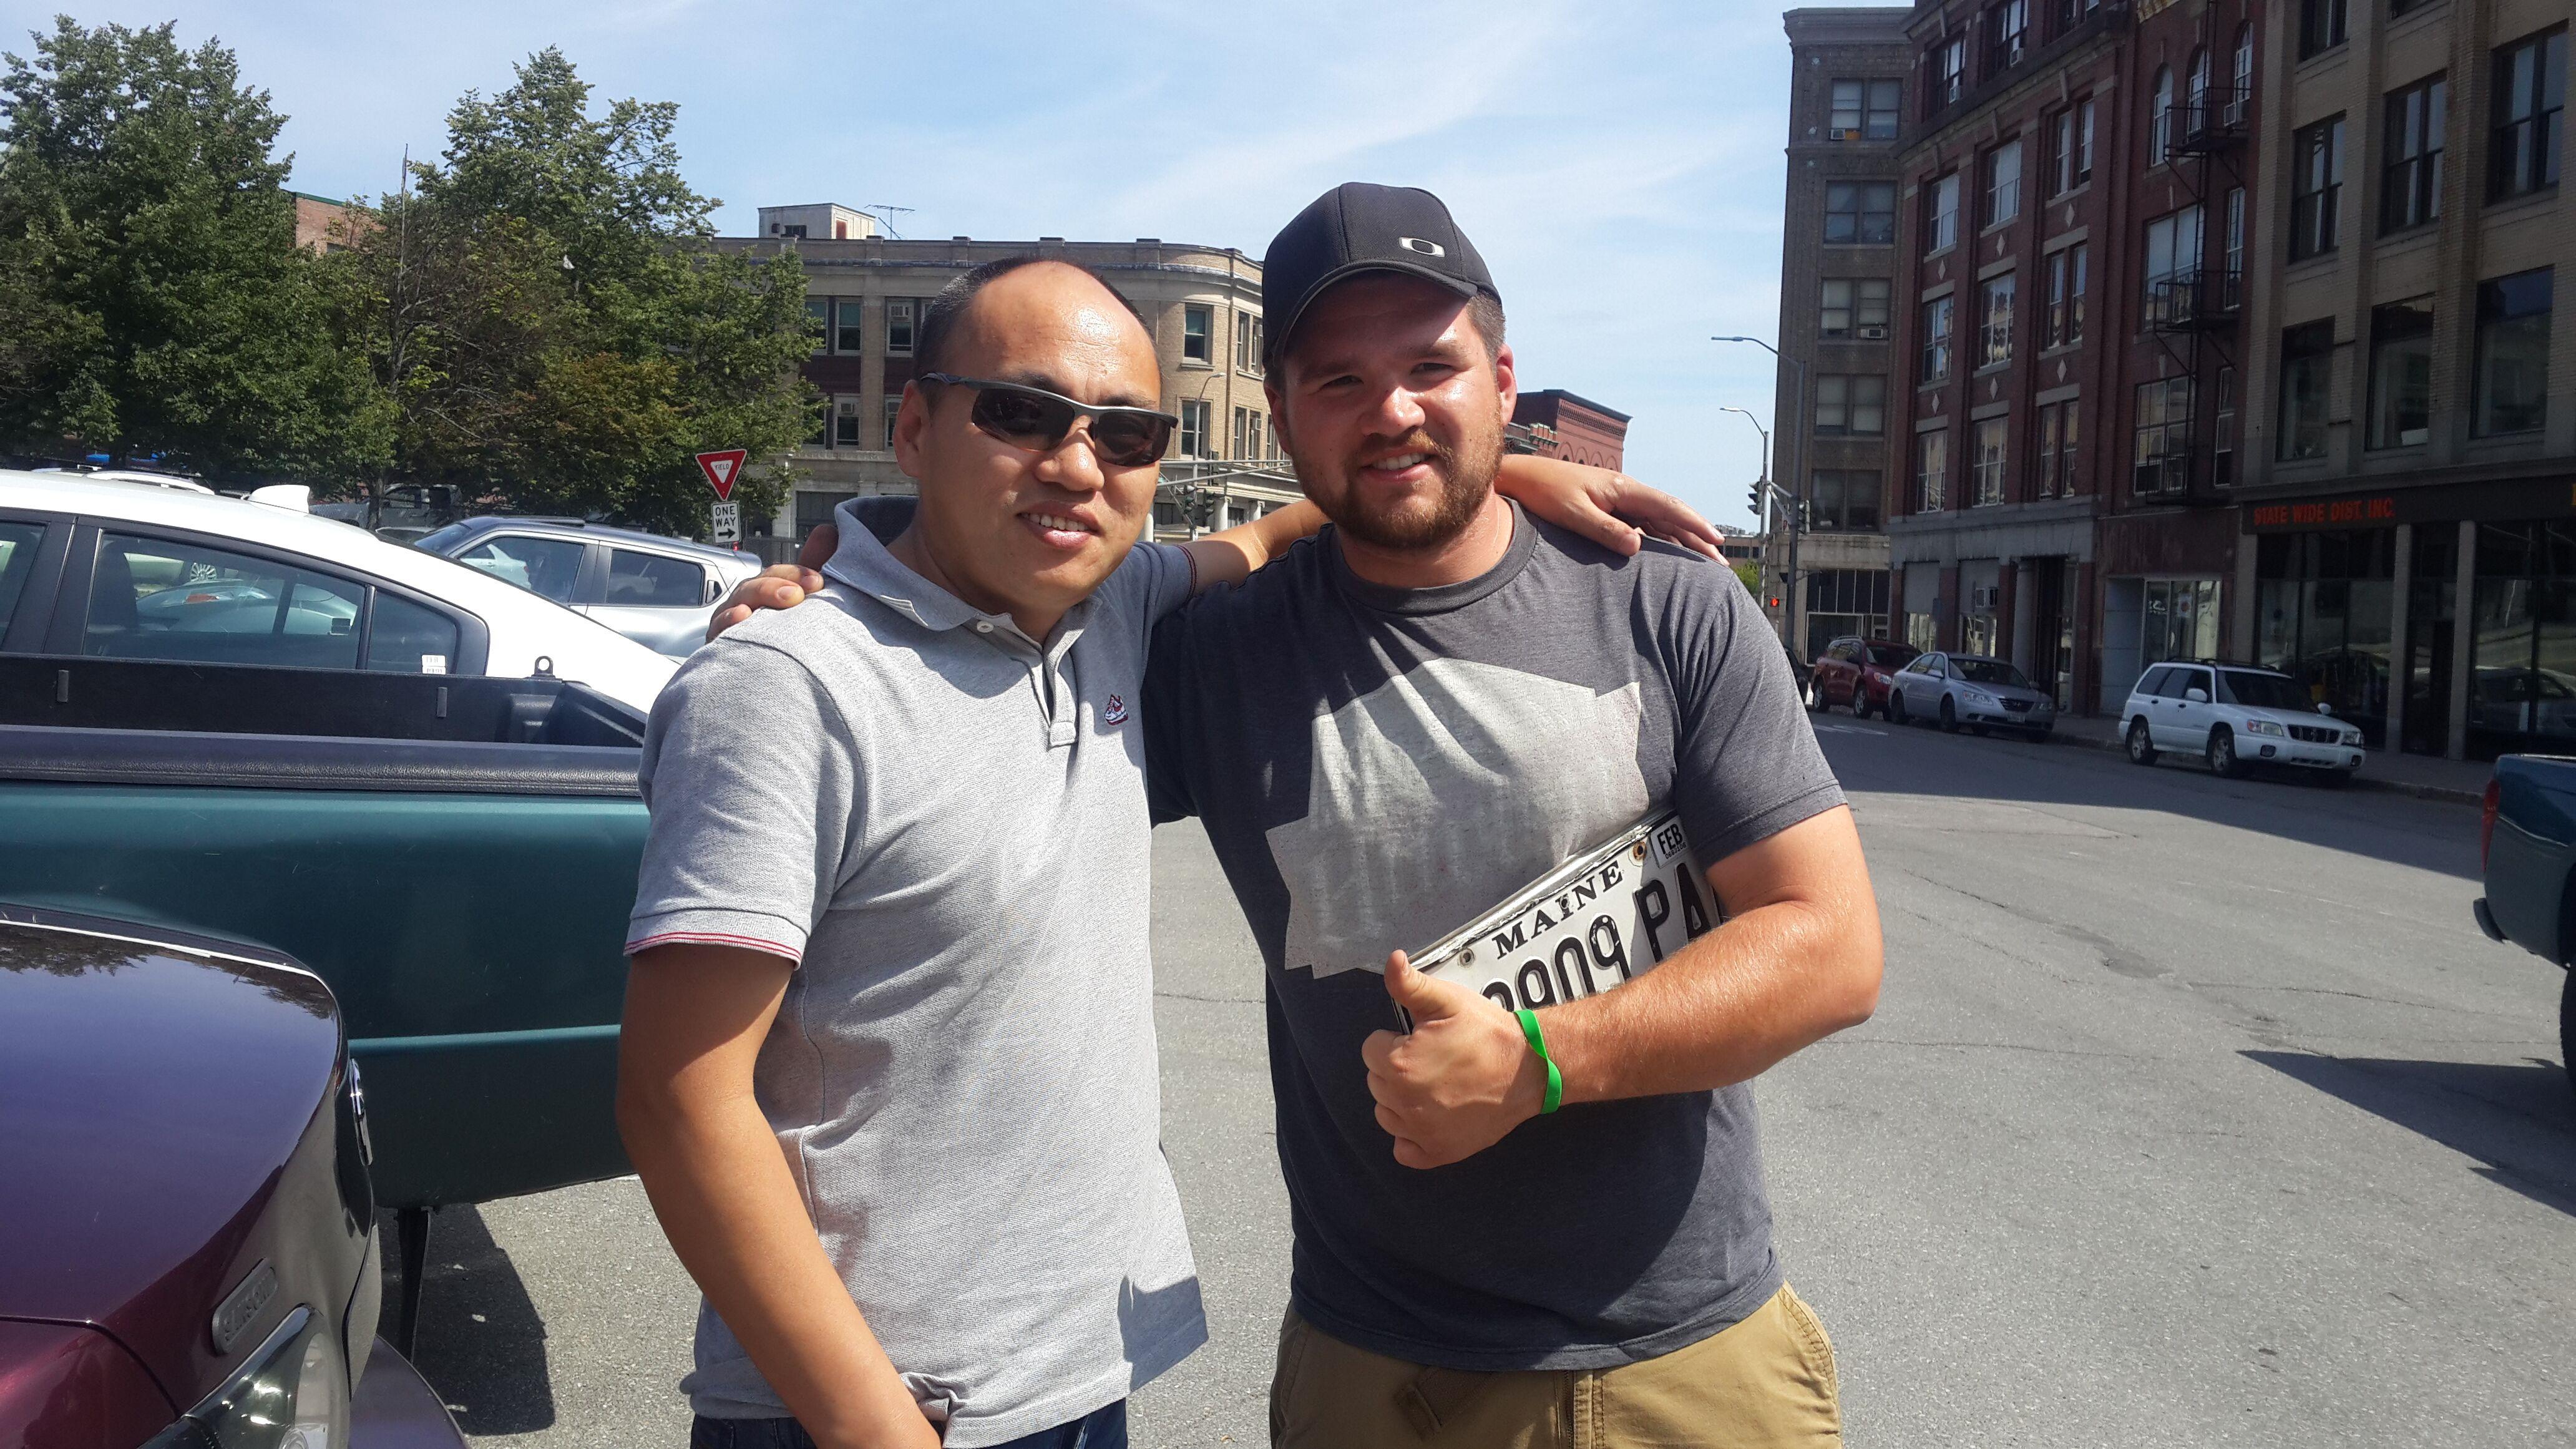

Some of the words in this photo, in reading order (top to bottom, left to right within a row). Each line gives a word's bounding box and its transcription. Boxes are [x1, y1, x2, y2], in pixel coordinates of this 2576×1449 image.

[715, 505, 735, 516] ONE
[2253, 506, 2288, 526] STATE
[2292, 504, 2326, 524] WIDE
[716, 517, 736, 527] WAY
[1657, 824, 1683, 855] FEB
[1492, 860, 1623, 960] MAINE
